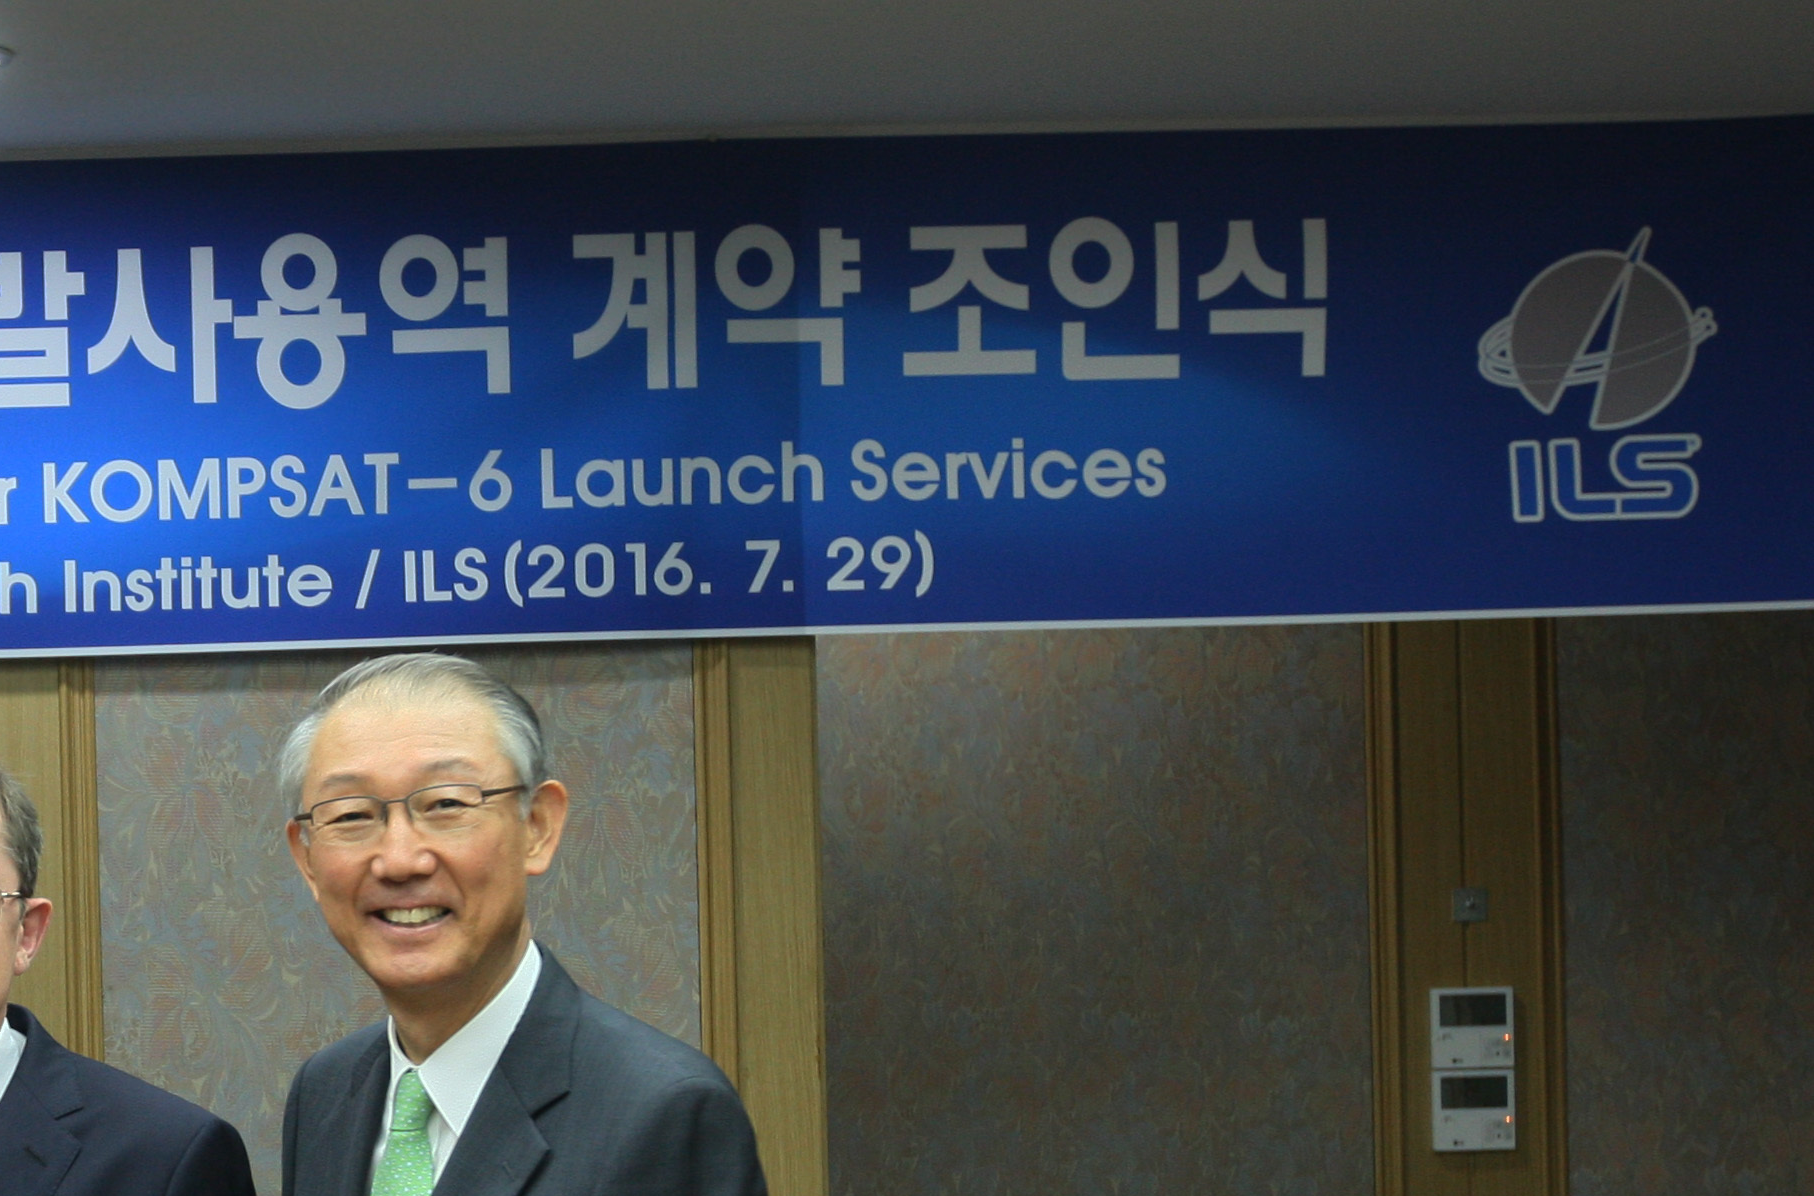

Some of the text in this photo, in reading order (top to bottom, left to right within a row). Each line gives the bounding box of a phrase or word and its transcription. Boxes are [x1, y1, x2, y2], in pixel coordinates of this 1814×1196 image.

[572, 224, 862, 390] 계약
[902, 216, 1328, 382] 조인식
[42, 448, 514, 525] KOMPSAT-6
[540, 440, 825, 510] Launch
[850, 437, 1167, 502] Services
[1508, 432, 1703, 523] ILS
[63, 553, 334, 614] Institute
[354, 548, 381, 610] /
[826, 529, 935, 598] 29)
